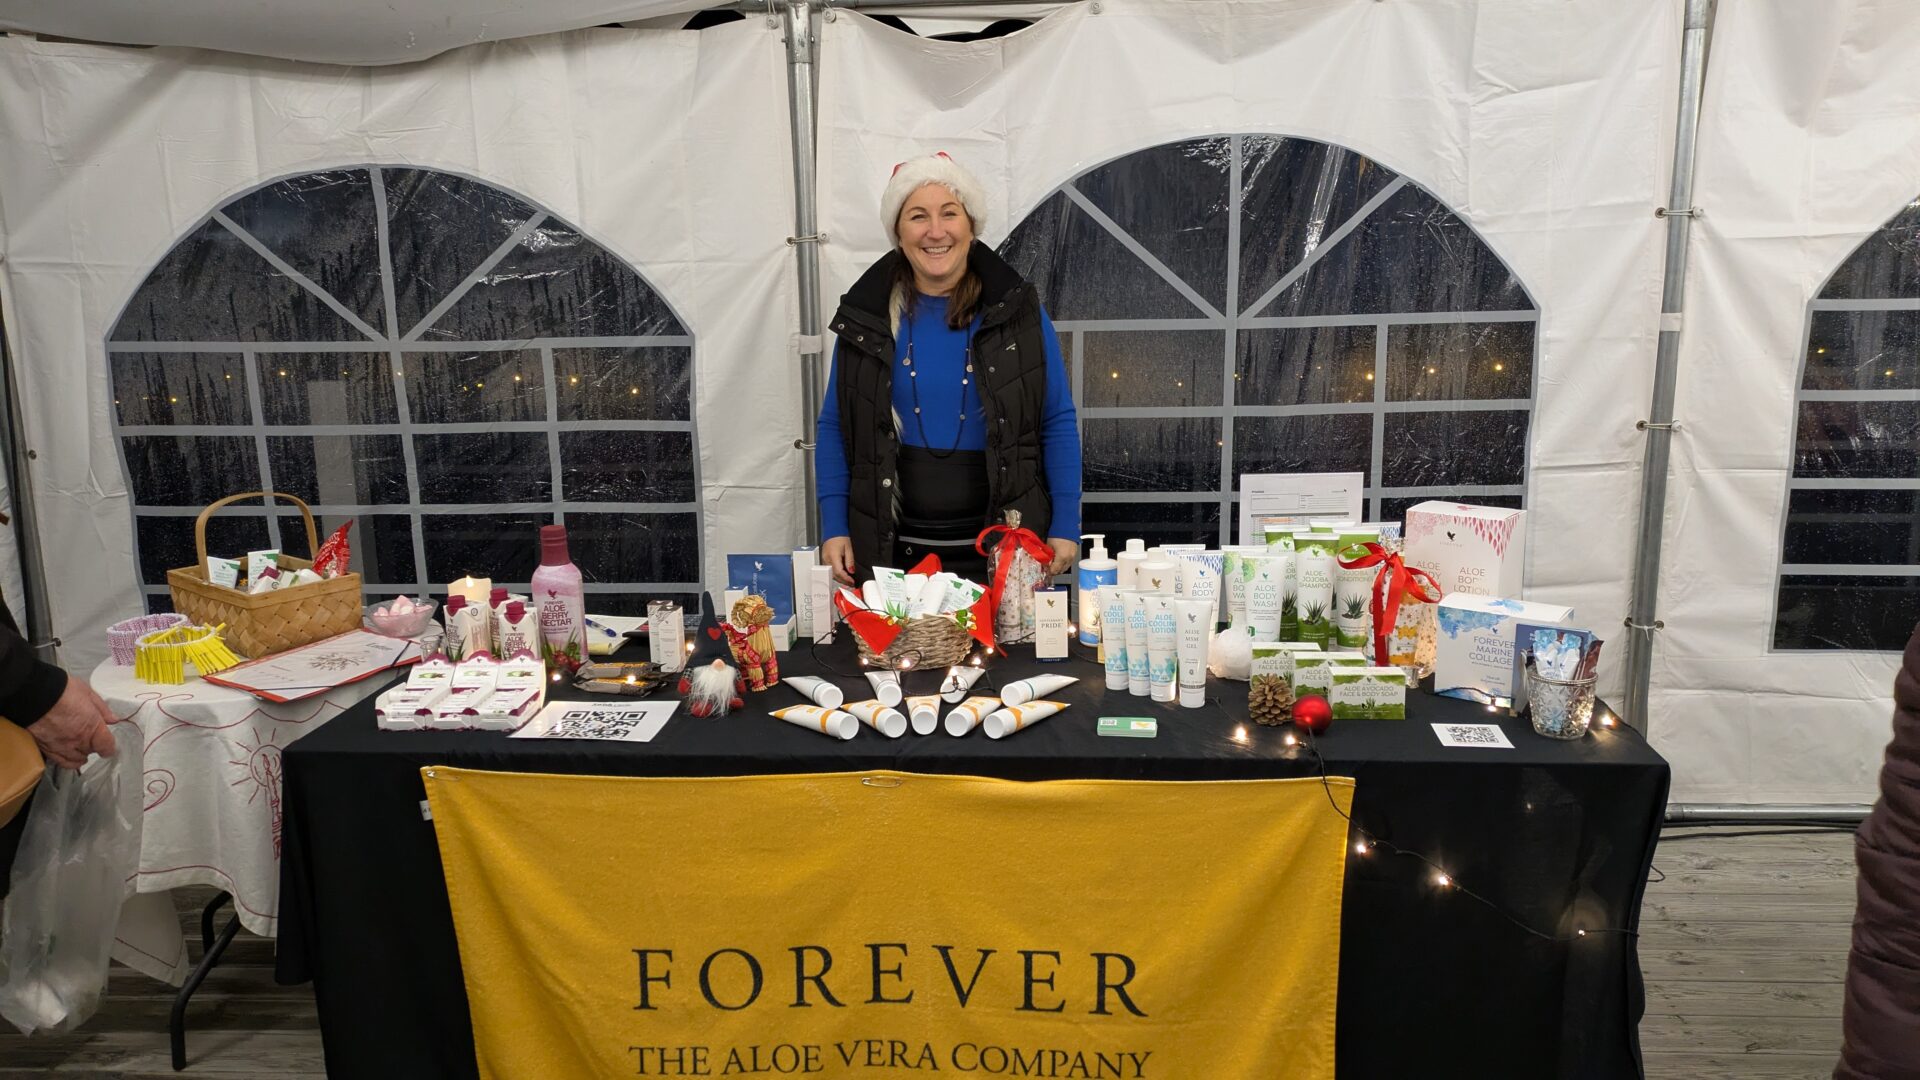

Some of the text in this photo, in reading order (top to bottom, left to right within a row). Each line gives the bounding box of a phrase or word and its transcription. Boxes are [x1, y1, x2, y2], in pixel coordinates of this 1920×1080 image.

[1416, 561, 1440, 570] ALOE
[1459, 567, 1486, 576] ALOE
[1192, 581, 1214, 589] ALOE
[1191, 589, 1215, 597] BODY
[1453, 585, 1490, 596] LOTION
[543, 604, 566, 612] ALOE
[1253, 600, 1277, 608] WASH
[541, 611, 569, 620] BERRY
[540, 619, 572, 627] NECTAR
[1473, 636, 1516, 649] FOREVER
[1475, 645, 1513, 657] MARINE
[1468, 652, 1513, 666] COLLAGE
[631, 943, 1149, 1018] FOREVER
[628, 1039, 1154, 1080] THE ALOE VERA COMPANY
